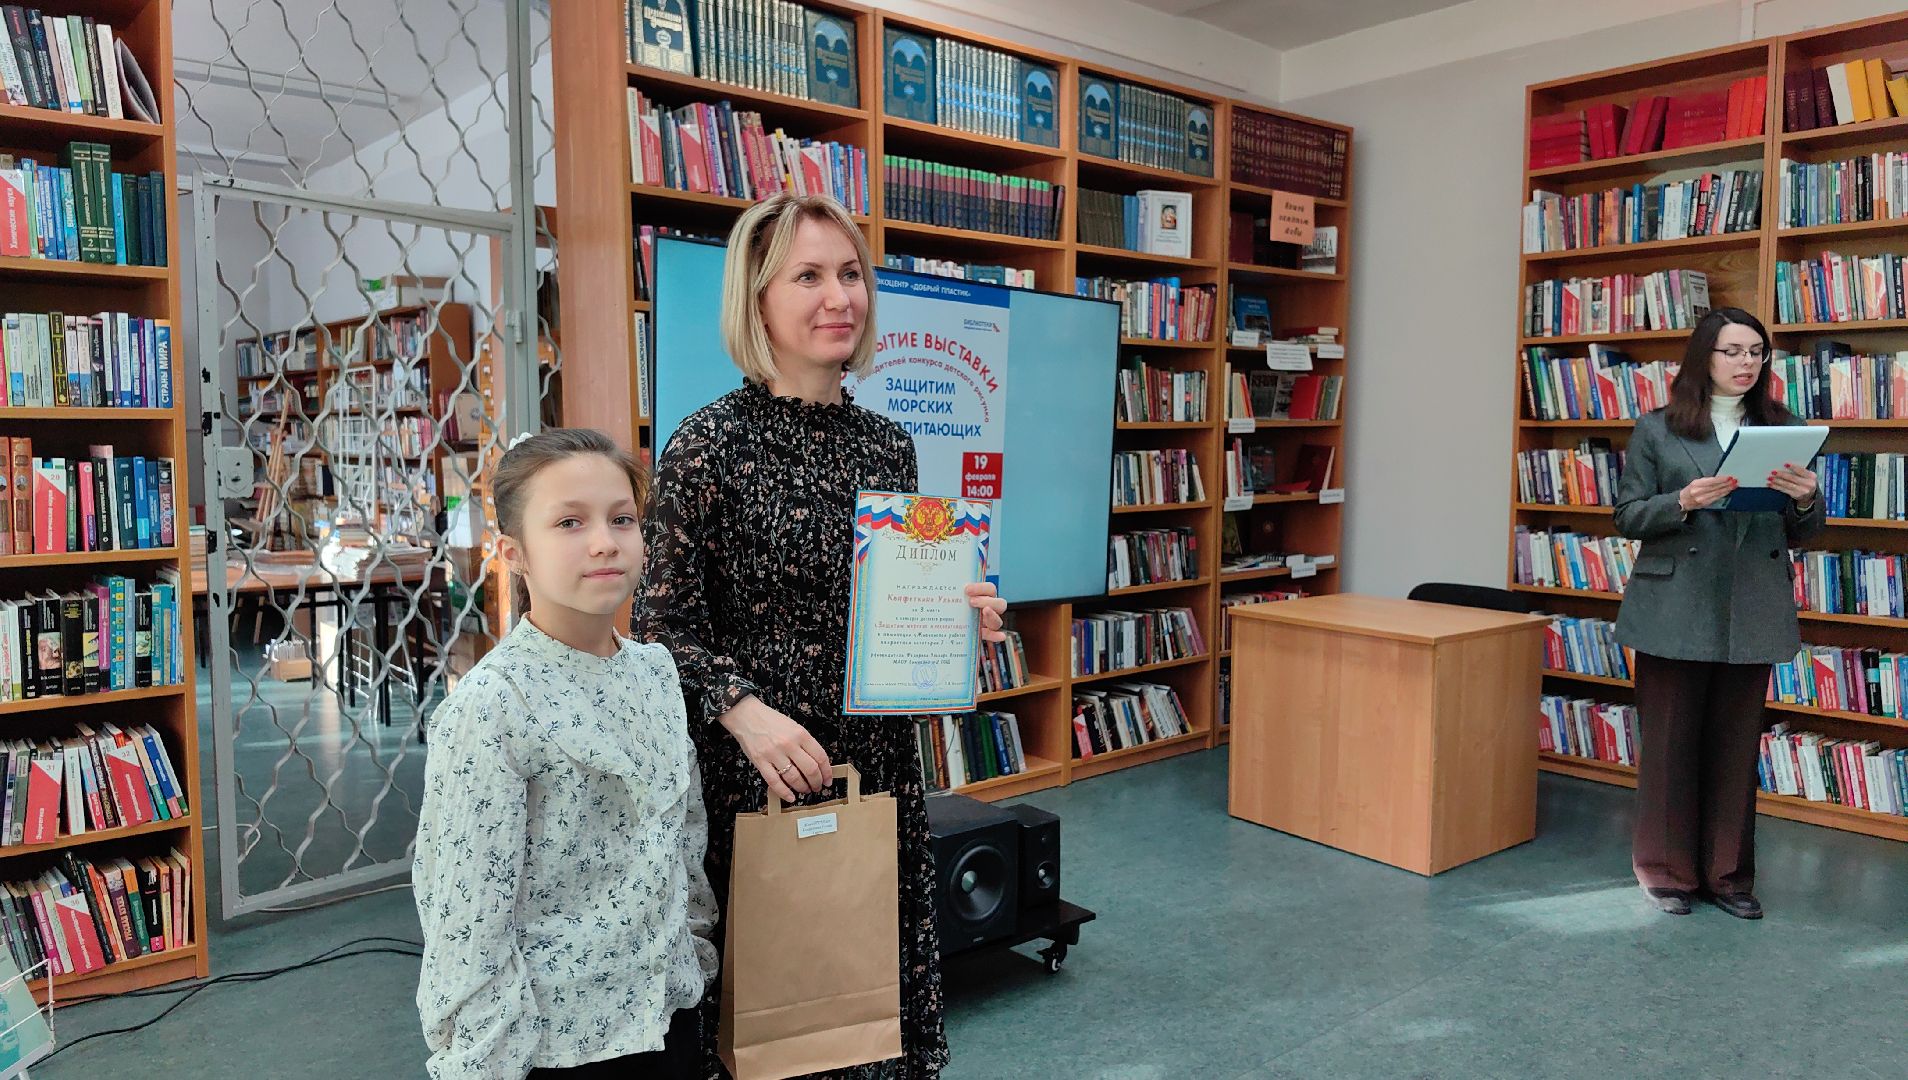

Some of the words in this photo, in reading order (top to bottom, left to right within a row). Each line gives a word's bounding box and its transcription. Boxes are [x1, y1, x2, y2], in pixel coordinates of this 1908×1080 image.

[7, 187, 16, 208] науки
[876, 278, 909, 289] ЭКОЦЕНТР
[159, 340, 168, 370] МИРА
[924, 332, 999, 393] ВЫСТАВКИ
[161, 370, 170, 405] СТРАНЫ
[886, 377, 956, 396] ЗАЩИТИМ
[908, 356, 943, 369] конкурса
[944, 363, 974, 388] детского
[973, 387, 990, 423] рисунка
[888, 398, 953, 415] МОРСКИХ
[896, 421, 982, 440] ПИТАЮЩИХ
[974, 455, 988, 470] 19
[965, 472, 996, 482] февраля
[967, 485, 993, 497] 14:00
[36, 808, 45, 841] Энергетика
[120, 915, 133, 942] РУССКАЯ
